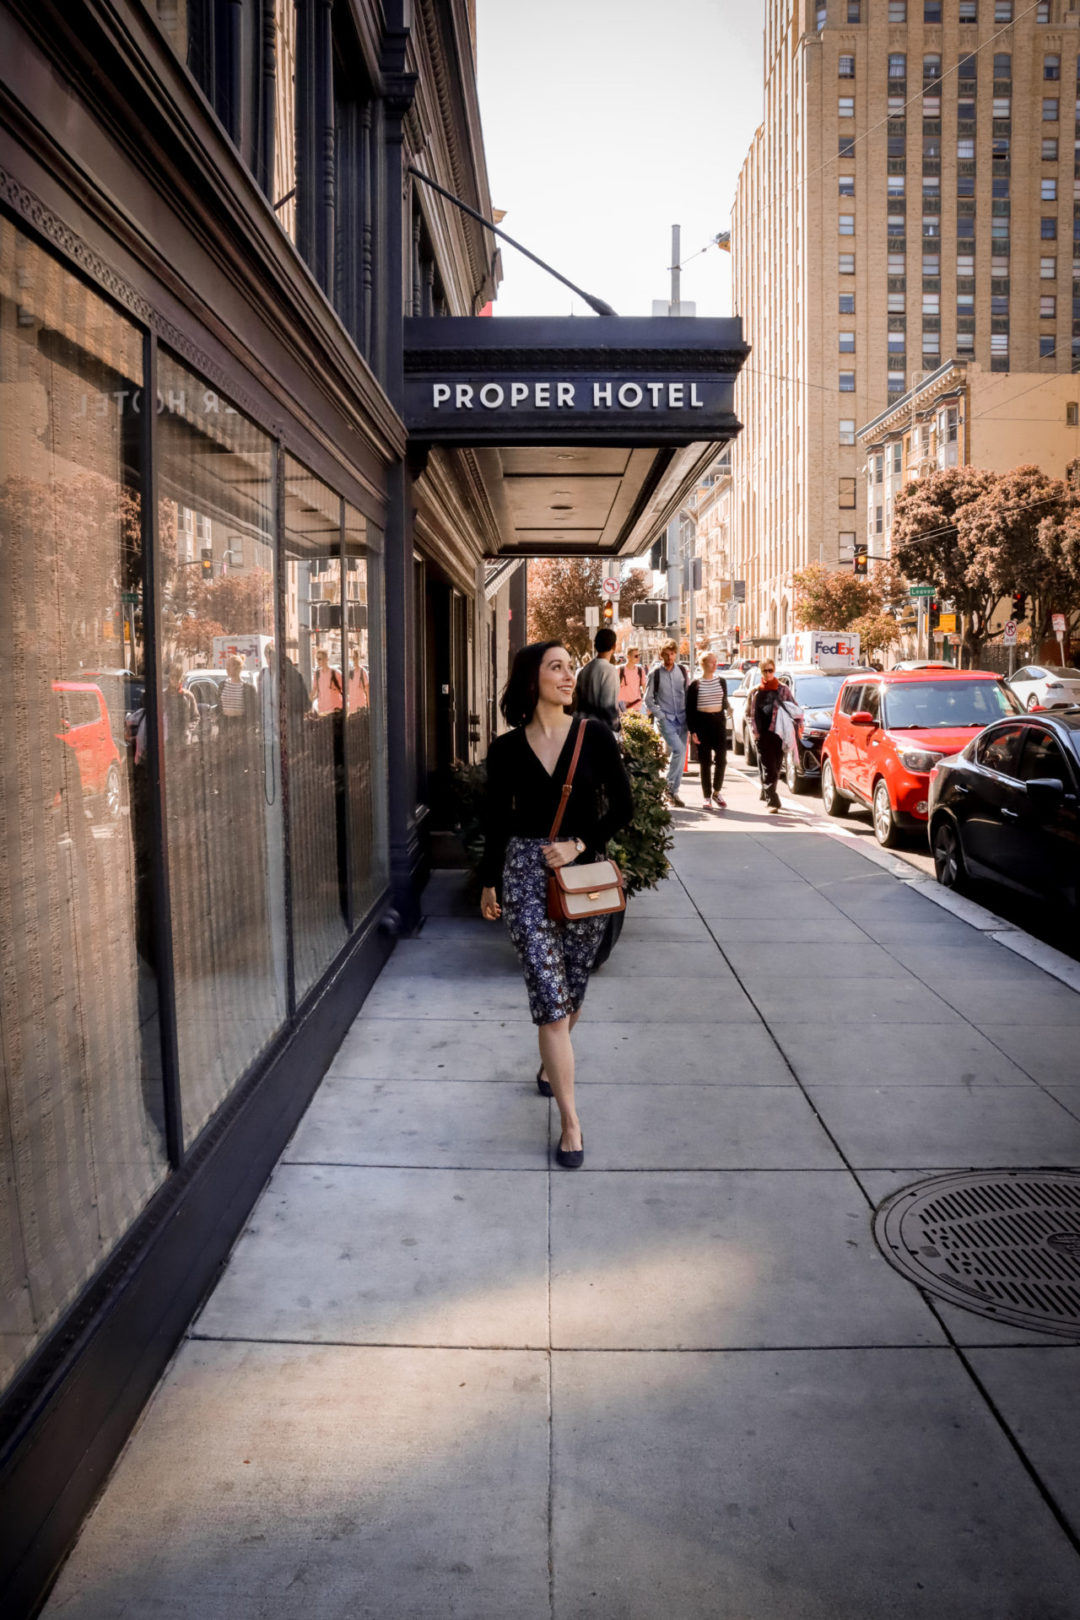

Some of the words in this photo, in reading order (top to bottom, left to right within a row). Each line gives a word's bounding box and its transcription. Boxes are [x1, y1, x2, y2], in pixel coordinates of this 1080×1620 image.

[432, 382, 576, 408] PROPER
[593, 382, 704, 408] HOTEL
[815, 641, 855, 656] FedEx
